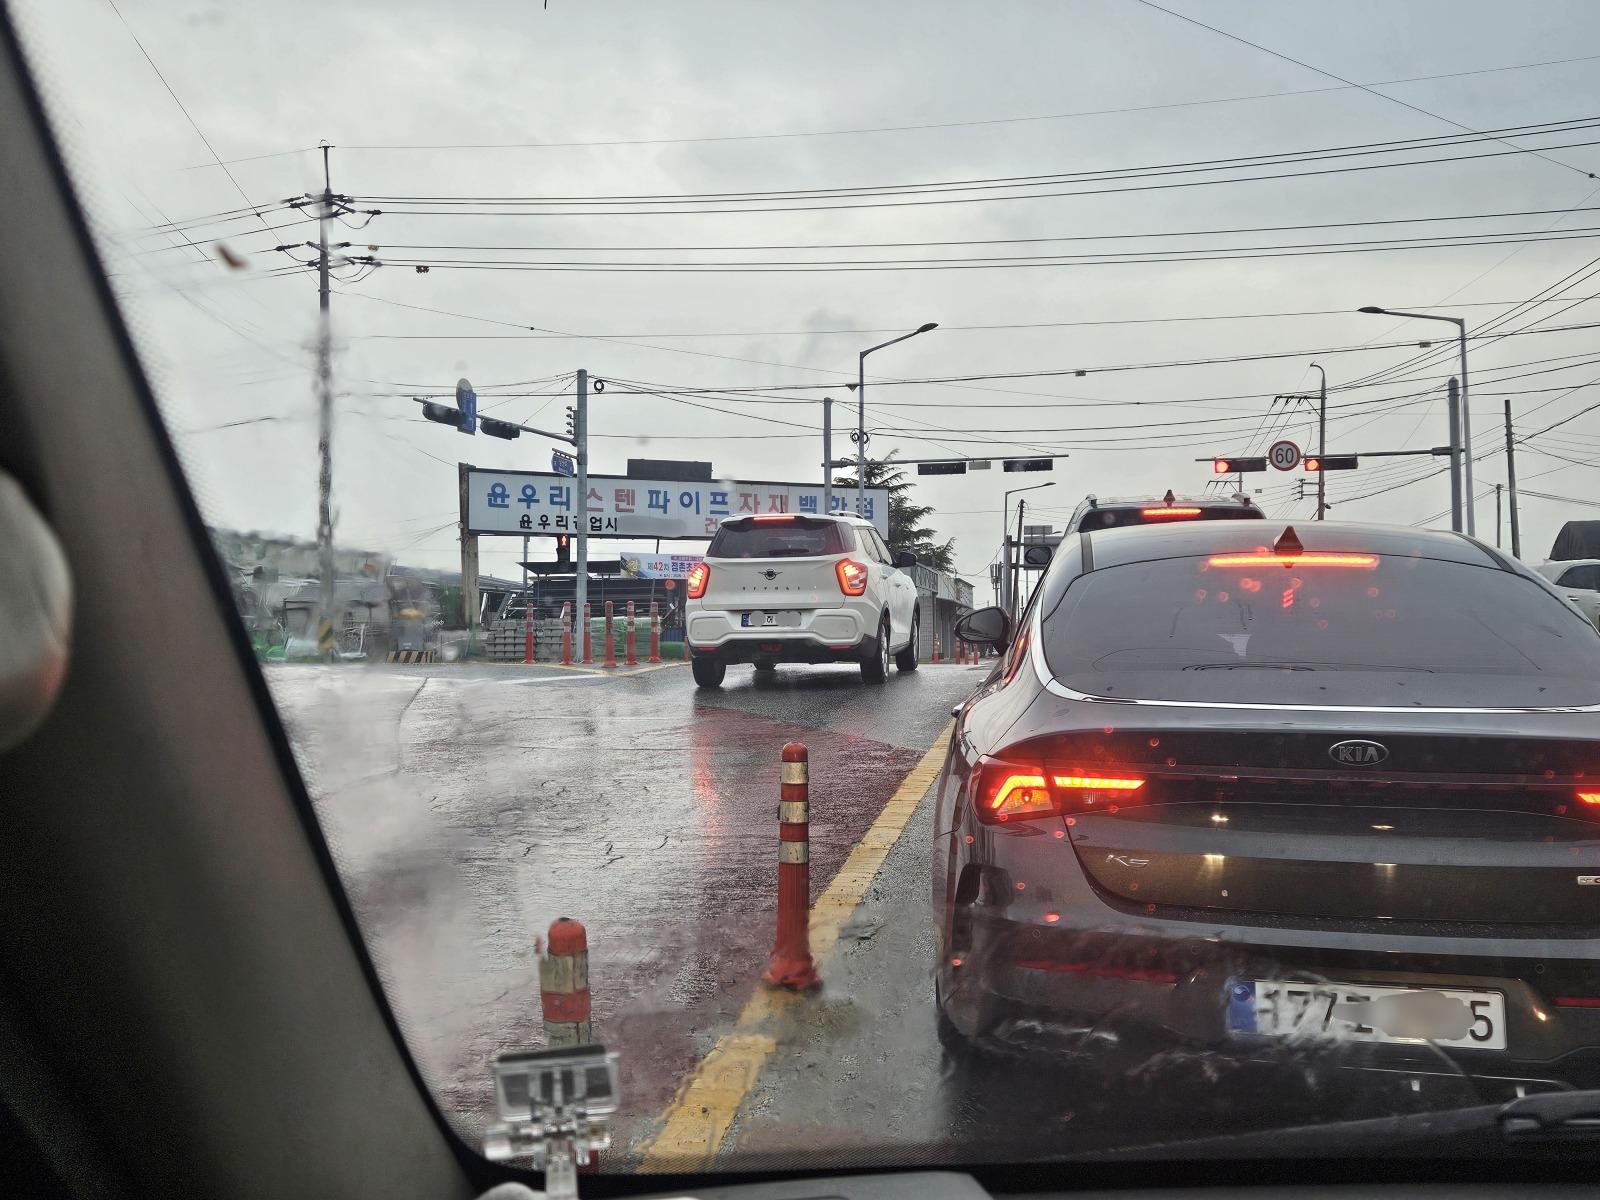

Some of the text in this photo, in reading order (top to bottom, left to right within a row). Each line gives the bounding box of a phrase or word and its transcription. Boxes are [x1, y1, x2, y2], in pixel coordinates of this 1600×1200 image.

[1275, 447, 1294, 464] 60
[487, 482, 571, 511] 윤우리
[647, 489, 730, 516] 파이프
[739, 492, 789, 515] 자재
[1338, 745, 1379, 762] KIA
[1105, 854, 1150, 868] K5
